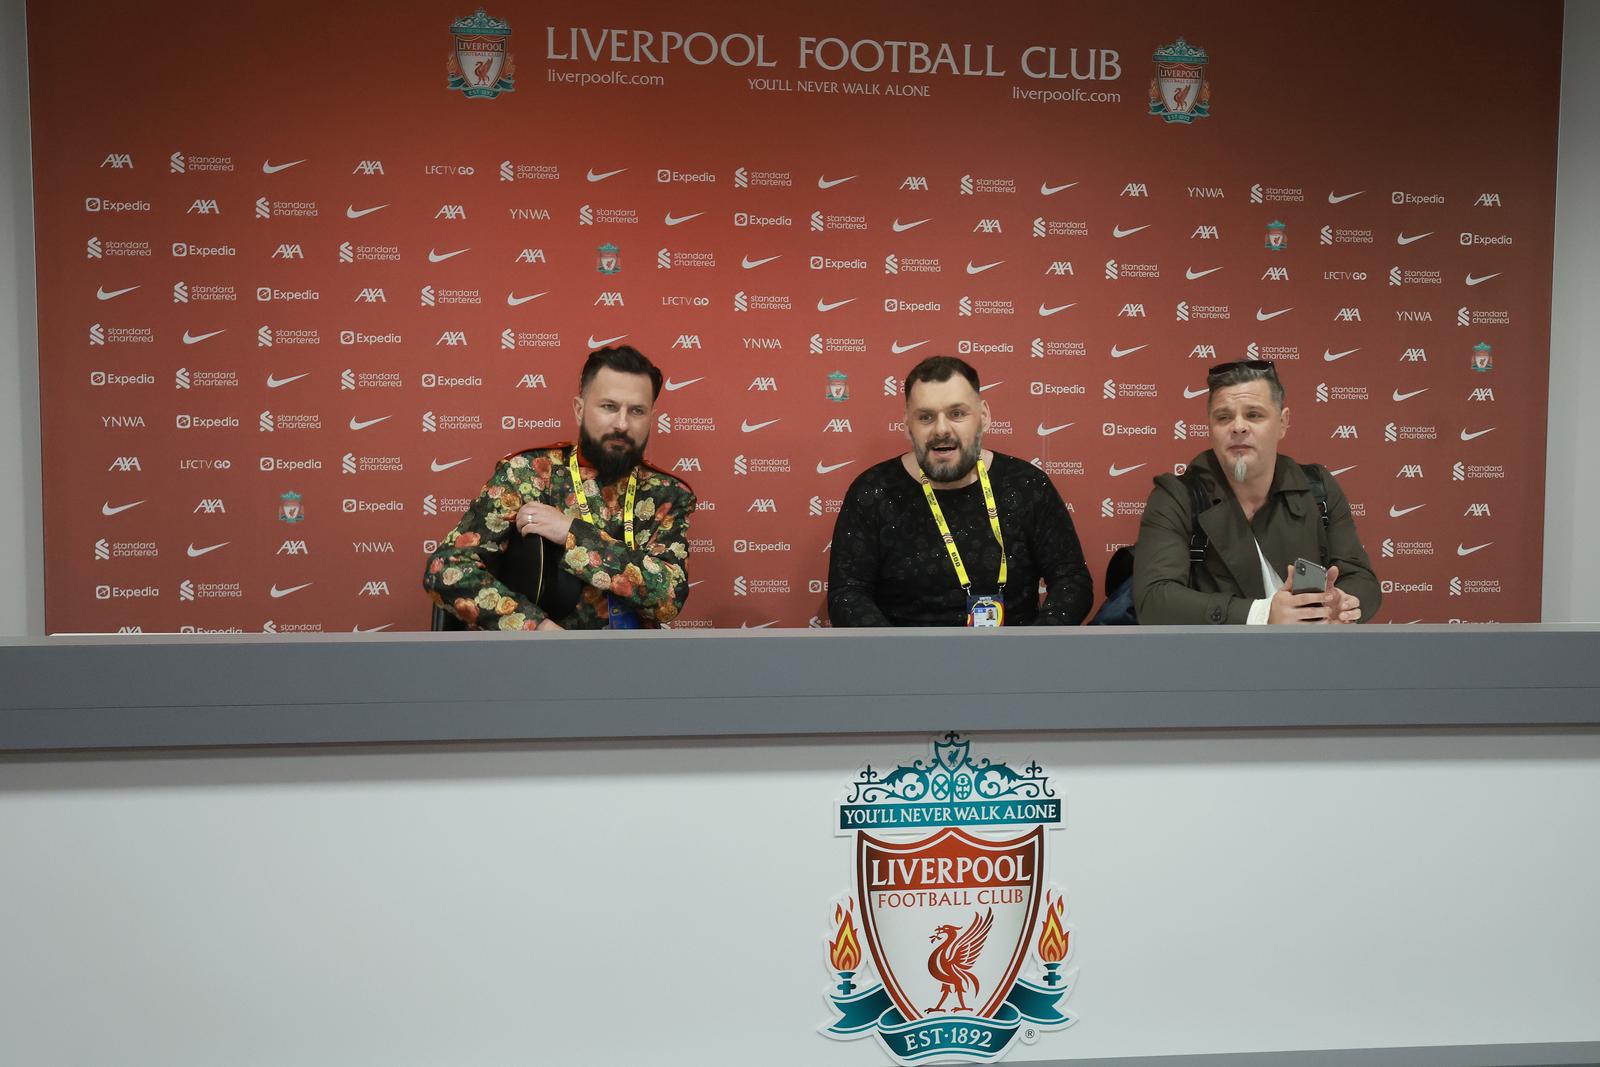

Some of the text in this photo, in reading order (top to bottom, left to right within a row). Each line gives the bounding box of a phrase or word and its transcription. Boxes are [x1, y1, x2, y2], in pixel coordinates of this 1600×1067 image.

[459, 42, 504, 51] LIVERPOOL
[546, 26, 1122, 81] LIVERPOOL FOOTBALL CLUB
[548, 68, 665, 87] liverpoolfc.com
[1160, 69, 1200, 78] LIVERPOOL
[748, 77, 930, 97] YOU'LL NEVER WALK ALONE
[1012, 86, 1121, 103] liverpoolfc.com
[100, 154, 133, 168] AXA
[188, 162, 234, 171] chartered
[353, 161, 384, 175] AXA
[672, 172, 715, 183] Expedia
[751, 178, 792, 186] chartered
[900, 177, 928, 190] AXA
[1120, 183, 1148, 197] AXA
[1188, 187, 1224, 198] YNWA
[1265, 194, 1304, 202] chartered
[1406, 194, 1444, 205] Expedia
[1474, 193, 1501, 206] AXA
[103, 200, 150, 212] Expedia
[187, 200, 220, 214] AXA
[274, 207, 319, 216] chartered
[435, 205, 466, 219] AXA
[510, 209, 550, 220] YNWA
[750, 215, 791, 227] Expedia
[827, 221, 867, 229] chartered
[973, 219, 1001, 233] AXA
[1191, 226, 1219, 239] AXA
[1335, 235, 1373, 243] chartered
[1474, 235, 1512, 245] Expedia
[189, 245, 235, 257] Expedia
[272, 244, 304, 258] AXA
[357, 251, 400, 260] chartered
[515, 249, 545, 263] AXA
[674, 258, 715, 266] chartered
[825, 259, 867, 270] Expedia
[1045, 262, 1073, 275] AXA
[1121, 270, 1159, 278] chartered
[1261, 267, 1289, 280] AXA
[192, 291, 236, 300] chartered
[274, 290, 319, 301] Expedia
[355, 288, 386, 302] AXA
[594, 292, 624, 306] AXA
[751, 302, 791, 310] chartered
[900, 301, 940, 312] Expedia
[975, 306, 1014, 314] chartered
[1118, 304, 1145, 317] AXA
[1334, 308, 1361, 321] AXA
[1397, 312, 1432, 321] YNWA
[1472, 317, 1509, 325] chartered
[276, 336, 320, 344] chartered
[357, 333, 401, 344] Expedia
[436, 332, 467, 345] AXA
[672, 335, 701, 349] AXA
[743, 338, 782, 349] YNWA
[826, 344, 866, 352] chartered
[973, 343, 1013, 354] Expedia
[1047, 348, 1086, 356] chartered
[1189, 345, 1216, 358] AXA
[1400, 349, 1427, 361] AXA
[108, 374, 154, 386] Expedia
[193, 377, 238, 386] chartered
[438, 376, 482, 387] Expedia
[516, 374, 547, 388] AXA
[748, 377, 777, 391] AXA
[1045, 384, 1085, 395] Expedia
[1119, 390, 1157, 398] chartered
[1468, 388, 1494, 401] AXA
[102, 416, 145, 427] YNWA
[193, 417, 239, 428] Expedia
[277, 420, 321, 429] chartered
[440, 421, 482, 429] chartered
[518, 418, 560, 429] Expedia
[823, 419, 852, 432] AXA
[1117, 425, 1156, 436] Expedia
[1331, 425, 1358, 438] AXA
[1400, 432, 1436, 440] chartered
[109, 457, 141, 471] AXA
[277, 459, 321, 471] Expedia
[672, 458, 701, 471] AXA
[750, 464, 790, 472] chartered
[1396, 465, 1423, 477] AXA
[1468, 471, 1504, 479] chartered
[194, 499, 225, 513] AXA
[359, 501, 403, 512] Expedia
[694, 500, 715, 511] edia
[747, 499, 776, 512] AXA
[1464, 504, 1490, 516] AXA
[113, 548, 158, 556] chartered
[277, 541, 308, 554] AXA
[353, 542, 394, 552] YNWA
[749, 542, 790, 552] Expedia
[113, 587, 159, 599] Expedia
[198, 589, 242, 597] chartered
[359, 581, 389, 595] AXA
[1395, 582, 1432, 593] Expedia
[1464, 585, 1501, 593] chartered
[844, 803, 1057, 825] YOU'LL NEVER WALK ALONE
[871, 855, 1032, 887] LIVERPOOL
[878, 888, 1024, 907] FOOTBALL CLUB
